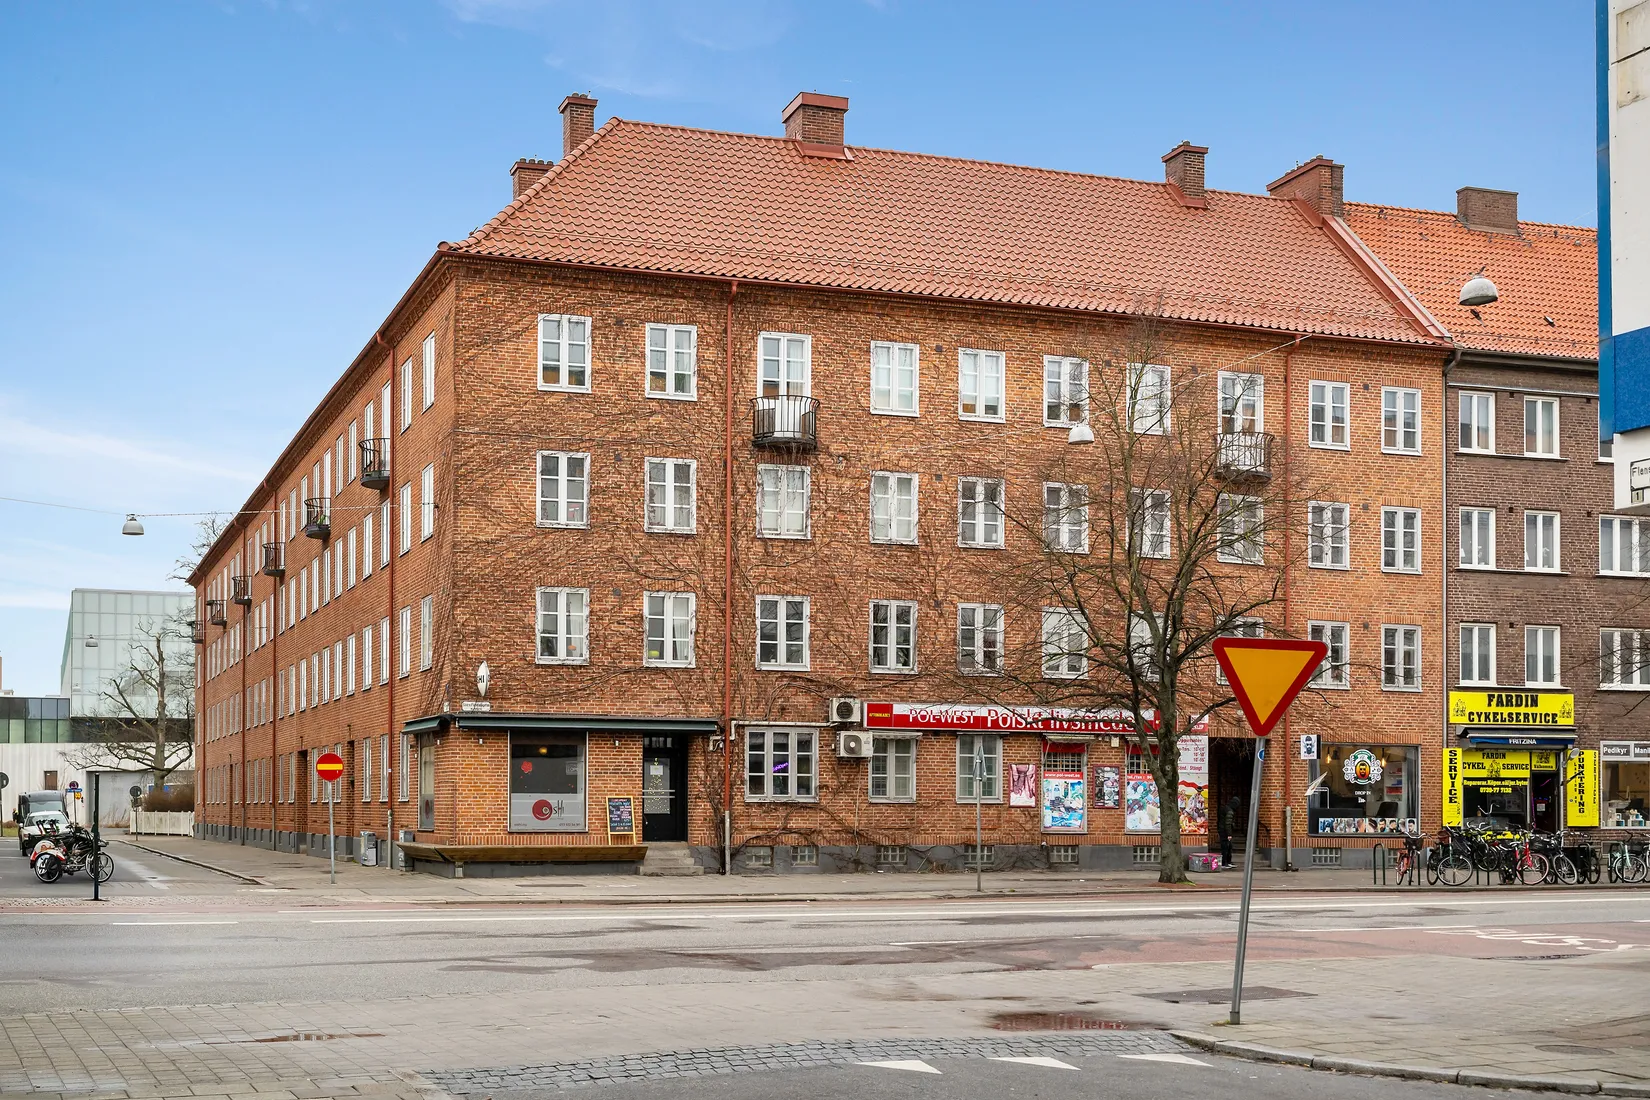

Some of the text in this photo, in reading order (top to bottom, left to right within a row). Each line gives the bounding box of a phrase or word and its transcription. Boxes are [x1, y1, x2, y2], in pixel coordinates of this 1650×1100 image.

[1487, 693, 1539, 708] FARDIN
[909, 708, 976, 724] POL-WEST
[987, 708, 1043, 729] Polskt
[1050, 709, 1134, 731] livsmede
[1468, 712, 1558, 724] CYKELSERVICE
[1462, 761, 1486, 770] CYKEL
[1448, 750, 1458, 804] SERVICE
